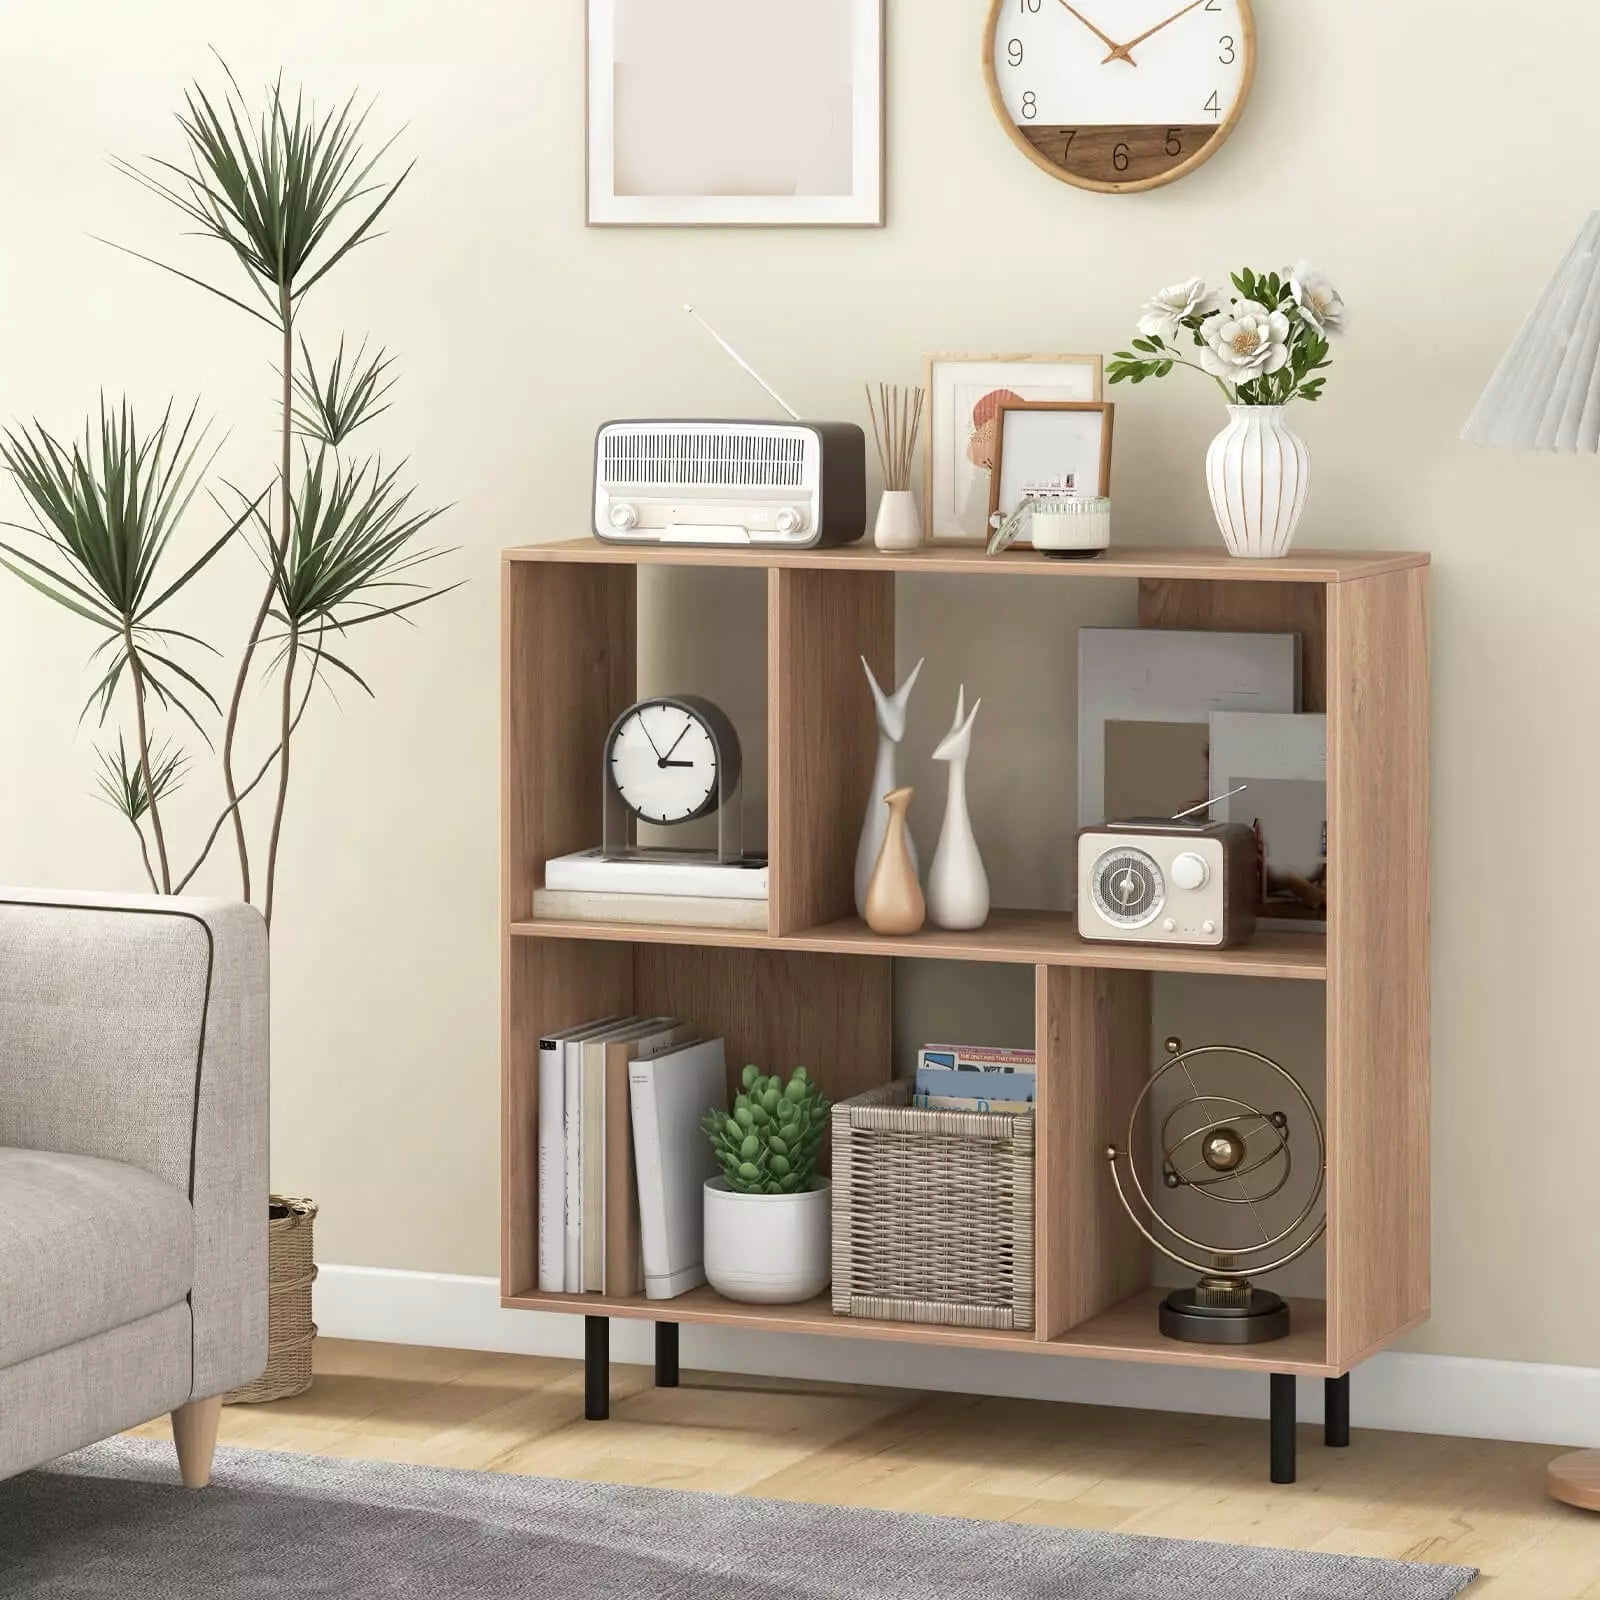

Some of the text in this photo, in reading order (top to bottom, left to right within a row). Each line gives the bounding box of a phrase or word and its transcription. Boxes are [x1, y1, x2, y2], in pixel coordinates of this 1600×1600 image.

[1007, 38, 1023, 67] 9
[1218, 35, 1235, 64] 3
[1021, 91, 1037, 119] 8
[1203, 90, 1222, 118] 4
[1059, 130, 1076, 160] 7
[1112, 143, 1129, 171] 6
[1164, 128, 1182, 157] 5
